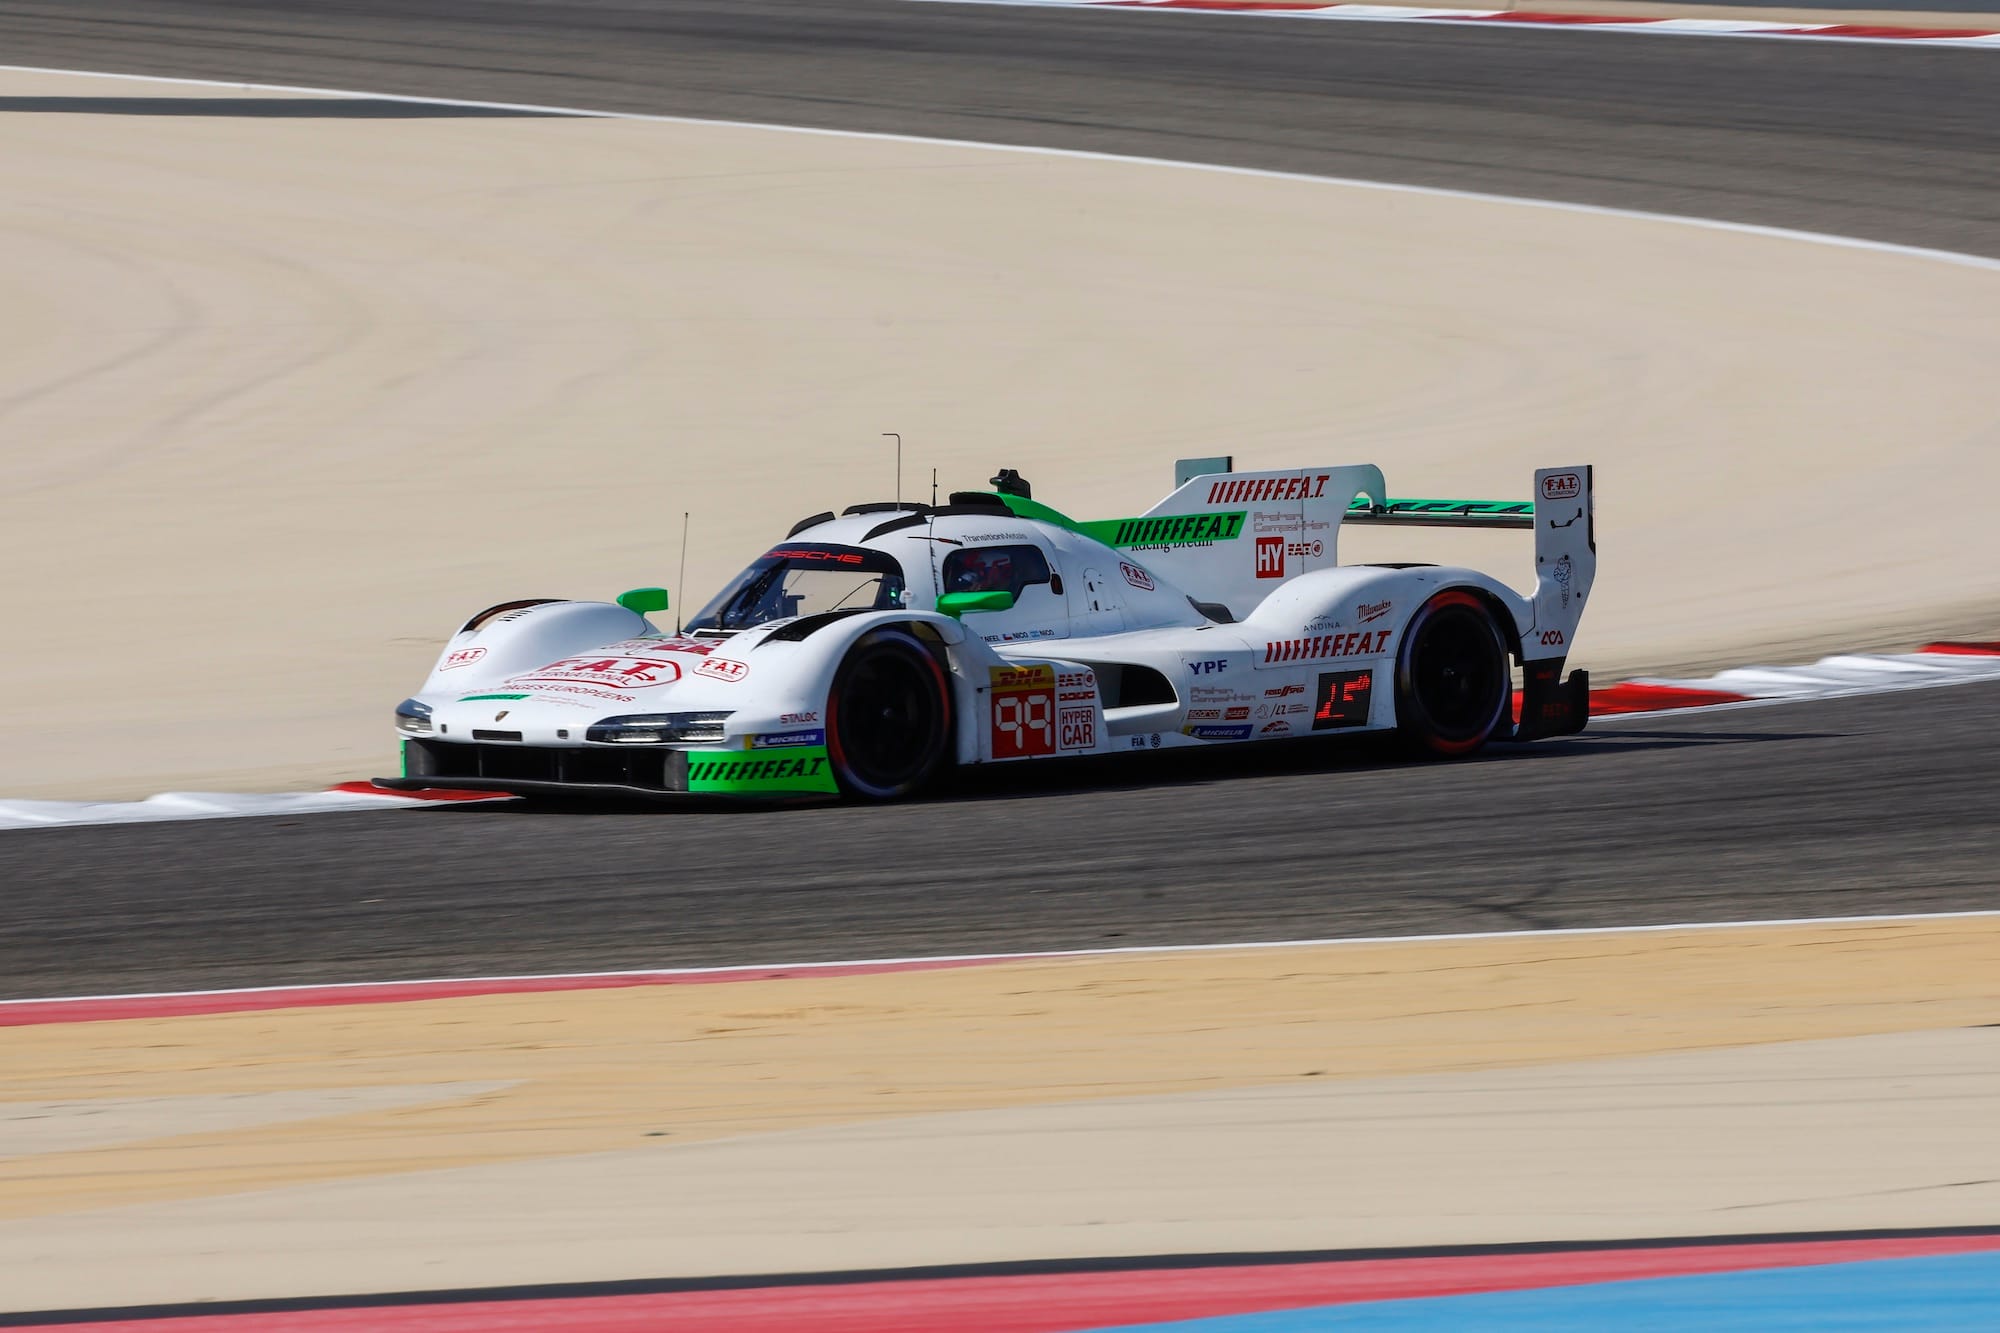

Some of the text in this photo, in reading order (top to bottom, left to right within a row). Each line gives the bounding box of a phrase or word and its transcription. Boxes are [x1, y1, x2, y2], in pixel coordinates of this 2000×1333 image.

[1257, 543, 1283, 572] HY
[1357, 600, 1392, 619] Milwaukee
[1303, 622, 1341, 632] ANDINA
[1189, 659, 1228, 675] YPF
[999, 668, 1043, 686] DHL
[780, 711, 818, 724] STALOC
[995, 694, 1052, 750] 99
[1061, 709, 1093, 725] HYPER
[767, 734, 818, 745] MICHELIN
[1062, 724, 1093, 746] CAR
[1131, 738, 1145, 747] FIA
